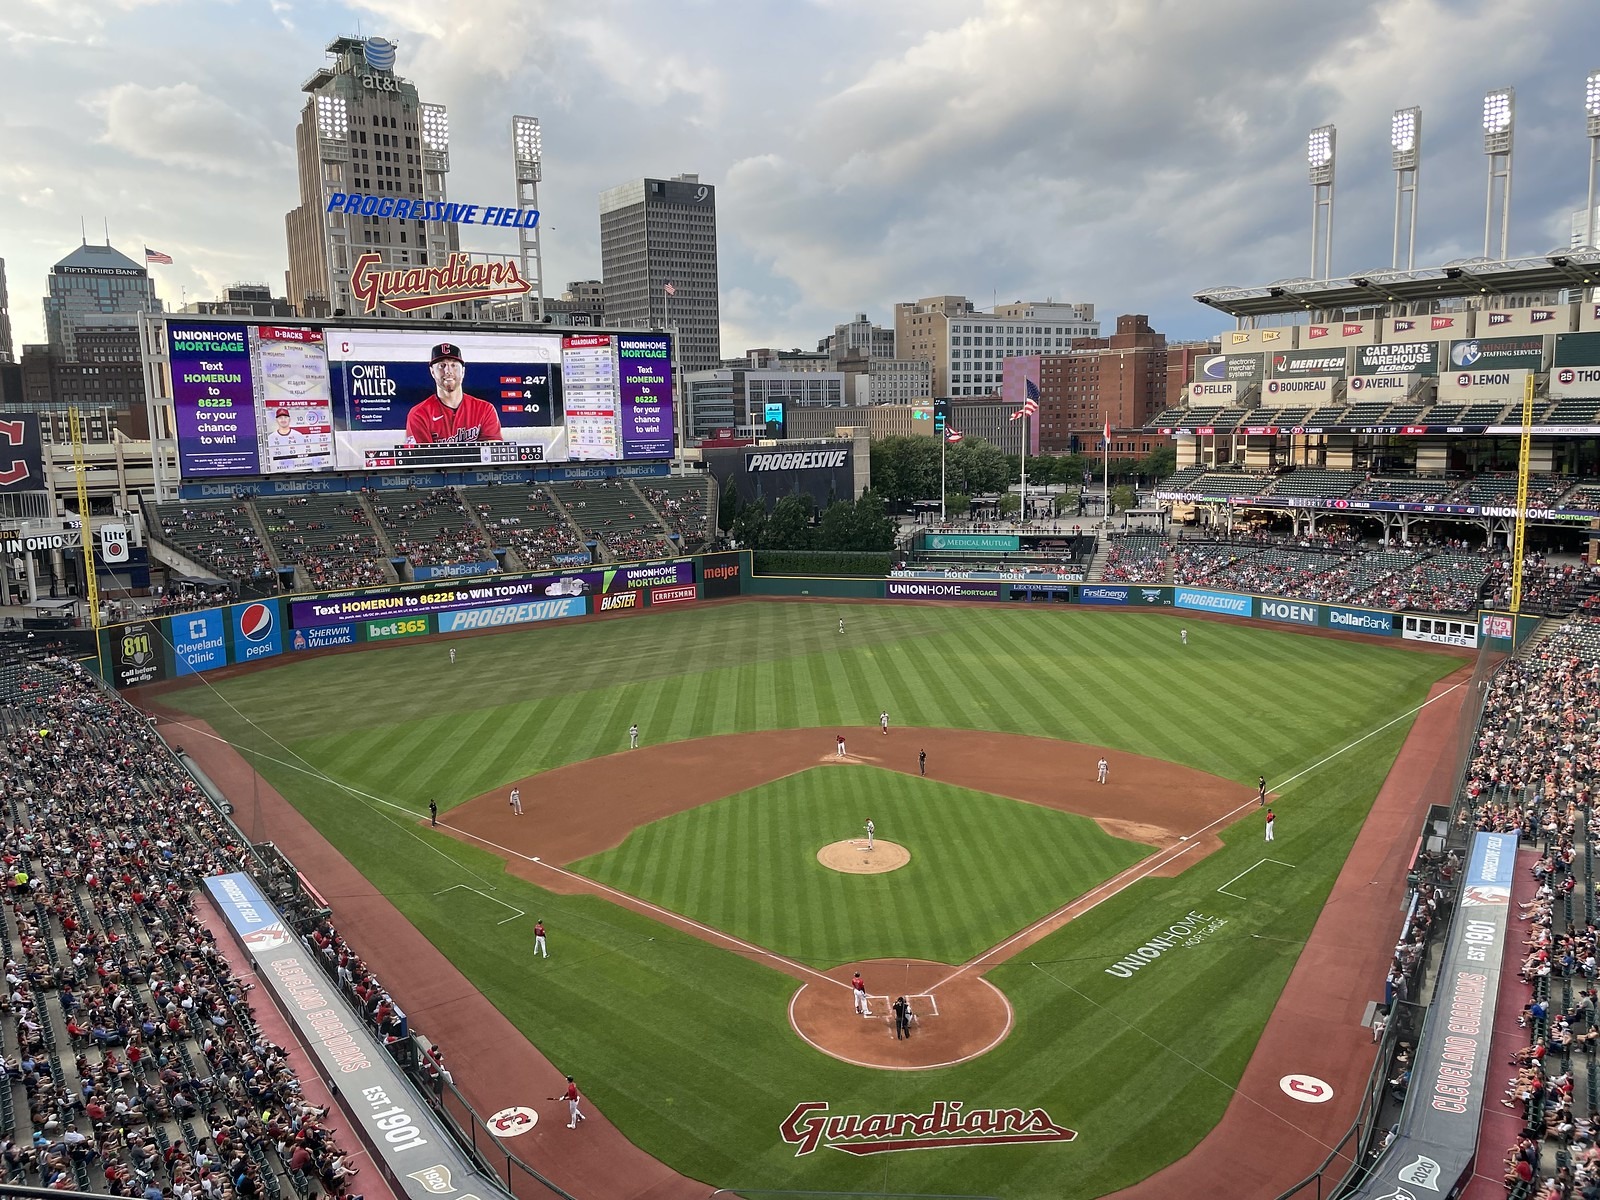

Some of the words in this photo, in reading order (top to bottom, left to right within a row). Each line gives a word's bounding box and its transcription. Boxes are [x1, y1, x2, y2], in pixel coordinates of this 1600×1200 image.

[362, 74, 402, 93] at&t
[327, 193, 477, 224] PROGRESSIVE
[485, 206, 540, 229] FIELD
[88, 267, 114, 275] THIRD
[115, 268, 138, 276] BANK
[350, 252, 532, 313] Guardians
[1533, 312, 1547, 320] 1999
[1396, 322, 1408, 330] 1996
[1433, 319, 1446, 327] 1997
[173, 330, 244, 341] UNIONHOME
[275, 330, 303, 339] D-BACKS
[1345, 326, 1357, 334] 1995
[174, 342, 244, 352] MORTGAGE
[570, 338, 598, 346] GUARDIANS
[620, 341, 667, 350] UNIONHOME
[621, 350, 667, 358] MORTGAGE
[1366, 346, 1388, 356] CAR
[1391, 344, 1428, 354] PARTS
[1229, 357, 1257, 366] electronic
[1290, 357, 1345, 369] MERITECH
[1362, 353, 1431, 365] WAREHOUSE
[200, 361, 223, 371] Text
[351, 365, 386, 378] OWEN
[637, 366, 653, 374] Text
[184, 374, 241, 383] HOMERUN
[522, 376, 546, 385] .247
[626, 376, 664, 384] HOMERUN
[1473, 374, 1510, 385] LEMON
[1560, 372, 1573, 380] 25
[353, 379, 397, 396] MILLER
[1280, 381, 1326, 391] BOUDREAU
[1365, 378, 1404, 388] AVERILL
[208, 387, 220, 396] to
[523, 390, 532, 399] 4
[642, 386, 650, 394] to
[1194, 386, 1202, 394] 19
[1204, 384, 1233, 394] FELLER
[198, 399, 232, 408] 86225
[635, 396, 658, 404] 86225
[524, 404, 540, 413] 40
[645, 406, 661, 415] your
[196, 411, 210, 420] for
[212, 411, 237, 422] your
[198, 423, 237, 432] chance
[645, 425, 660, 433] win!
[201, 436, 212, 445] to
[214, 435, 236, 444] win!
[749, 451, 848, 472] PROGRESSIVE
[565, 468, 606, 478] DollarBank
[616, 466, 655, 475] DollarBank
[382, 475, 431, 486] DollarBank
[476, 471, 522, 482] DollarBank
[202, 483, 260, 495] DollarBank
[274, 480, 330, 492] DollarBank
[1156, 492, 1203, 501] UNIONHOME
[1481, 506, 1555, 519] UNIONHOME
[104, 531, 125, 542] Lite
[6, 539, 23, 553] IN
[26, 535, 63, 551] OHIO
[982, 539, 1011, 547] MUTUAL
[627, 567, 677, 579] UNIONHOME
[704, 564, 739, 579] meijer
[1000, 572, 1025, 580] MOEN
[1057, 573, 1083, 581] MOEN
[627, 575, 678, 588] MORTGAGE
[655, 590, 693, 600] CRAFTSMAN
[889, 584, 961, 595] UNIONHOME
[313, 604, 341, 616] Text
[342, 597, 404, 613] HOMERUN
[405, 596, 418, 607] to
[420, 592, 455, 604] 86225
[456, 591, 468, 600] to
[469, 587, 493, 599] WIN
[493, 583, 533, 596] TODAY!
[601, 594, 636, 611] BLASTER
[1179, 593, 1247, 611] PROGRESSIVE
[451, 600, 571, 631] PROGRESSIVE
[1262, 602, 1315, 621] MOEN
[1330, 612, 1390, 630] DollarBank
[1484, 616, 1507, 629] drug
[308, 626, 350, 639] SHERWIN
[370, 620, 426, 637] bet365
[124, 635, 149, 656] 811
[176, 636, 223, 655] Cleveland
[1431, 634, 1467, 646] CLIFFS
[246, 643, 273, 658] pepsi
[187, 652, 215, 665] Clinic
[121, 669, 134, 678] Call
[135, 666, 157, 674] before
[126, 676, 139, 685] you
[1181, 917, 1229, 948] MORTGAGE
[1464, 919, 1496, 945] 1901
[1104, 910, 1214, 978] UNIONHOME
[1467, 946, 1487, 961] EST.
[1448, 971, 1488, 1035] GUARDIANS
[271, 958, 328, 1011] CLEVELAND
[306, 1009, 372, 1073] GUARDIANS
[1431, 1035, 1478, 1114] CLEVELAND
[361, 1085, 391, 1110] EST.
[371, 1106, 428, 1152] 1901
[779, 1101, 1078, 1157] Guardians
[1411, 1161, 1435, 1184] 2020
[423, 1168, 447, 1190] 1920
